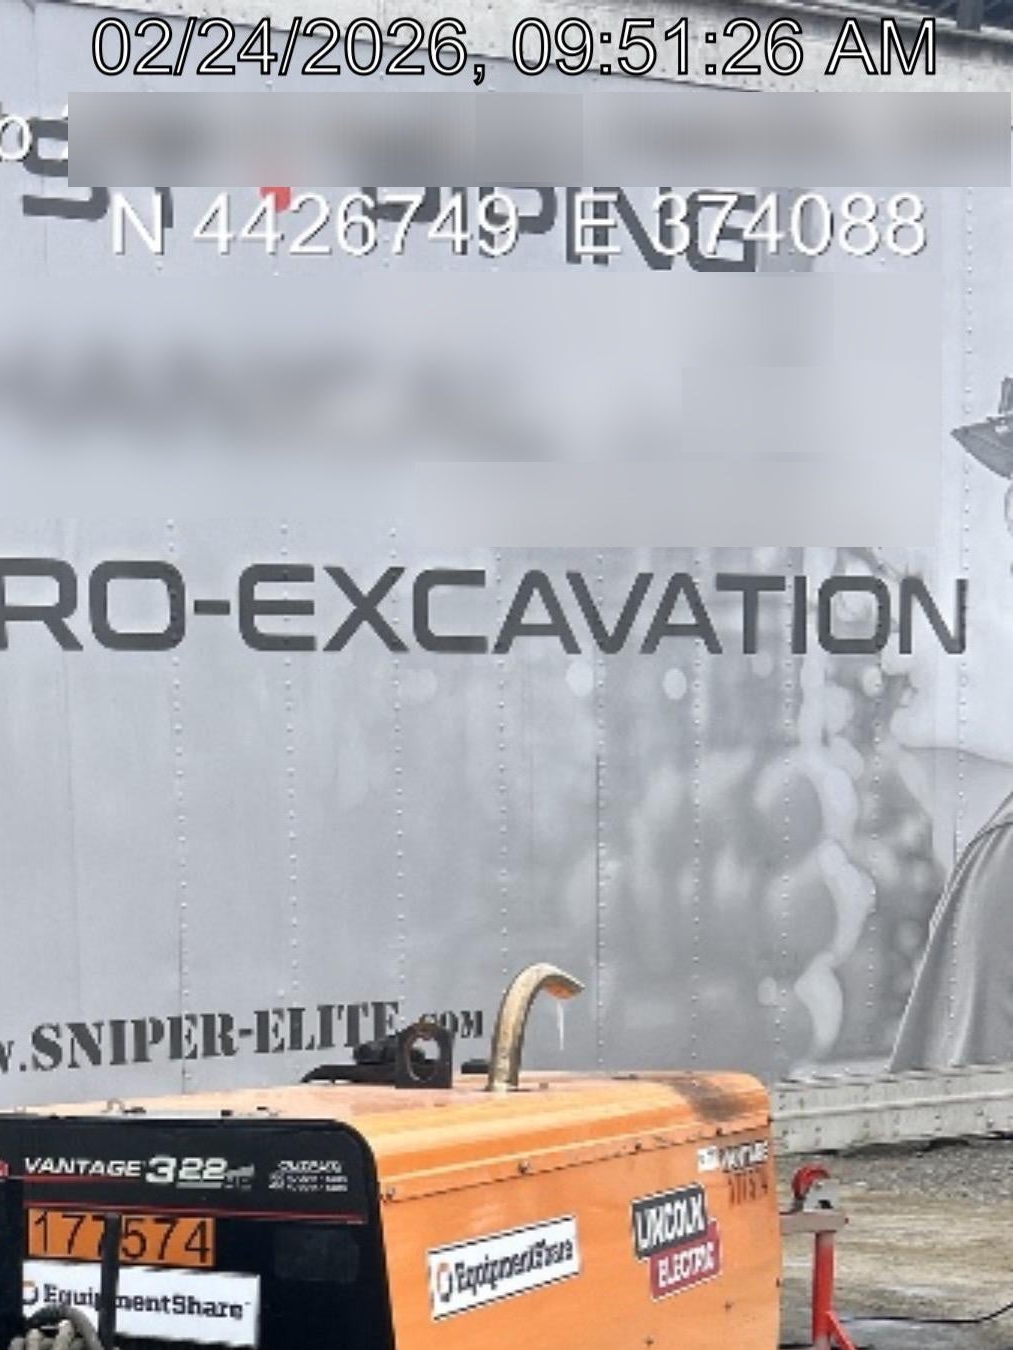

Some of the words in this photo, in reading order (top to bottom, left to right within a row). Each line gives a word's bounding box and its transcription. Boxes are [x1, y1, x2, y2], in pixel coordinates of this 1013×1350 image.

[24, 1157, 142, 1177] VANTAGE
[145, 1156, 228, 1184] 322
[635, 1193, 706, 1250] LINCOLN
[657, 1242, 716, 1289] ELECTRIC
